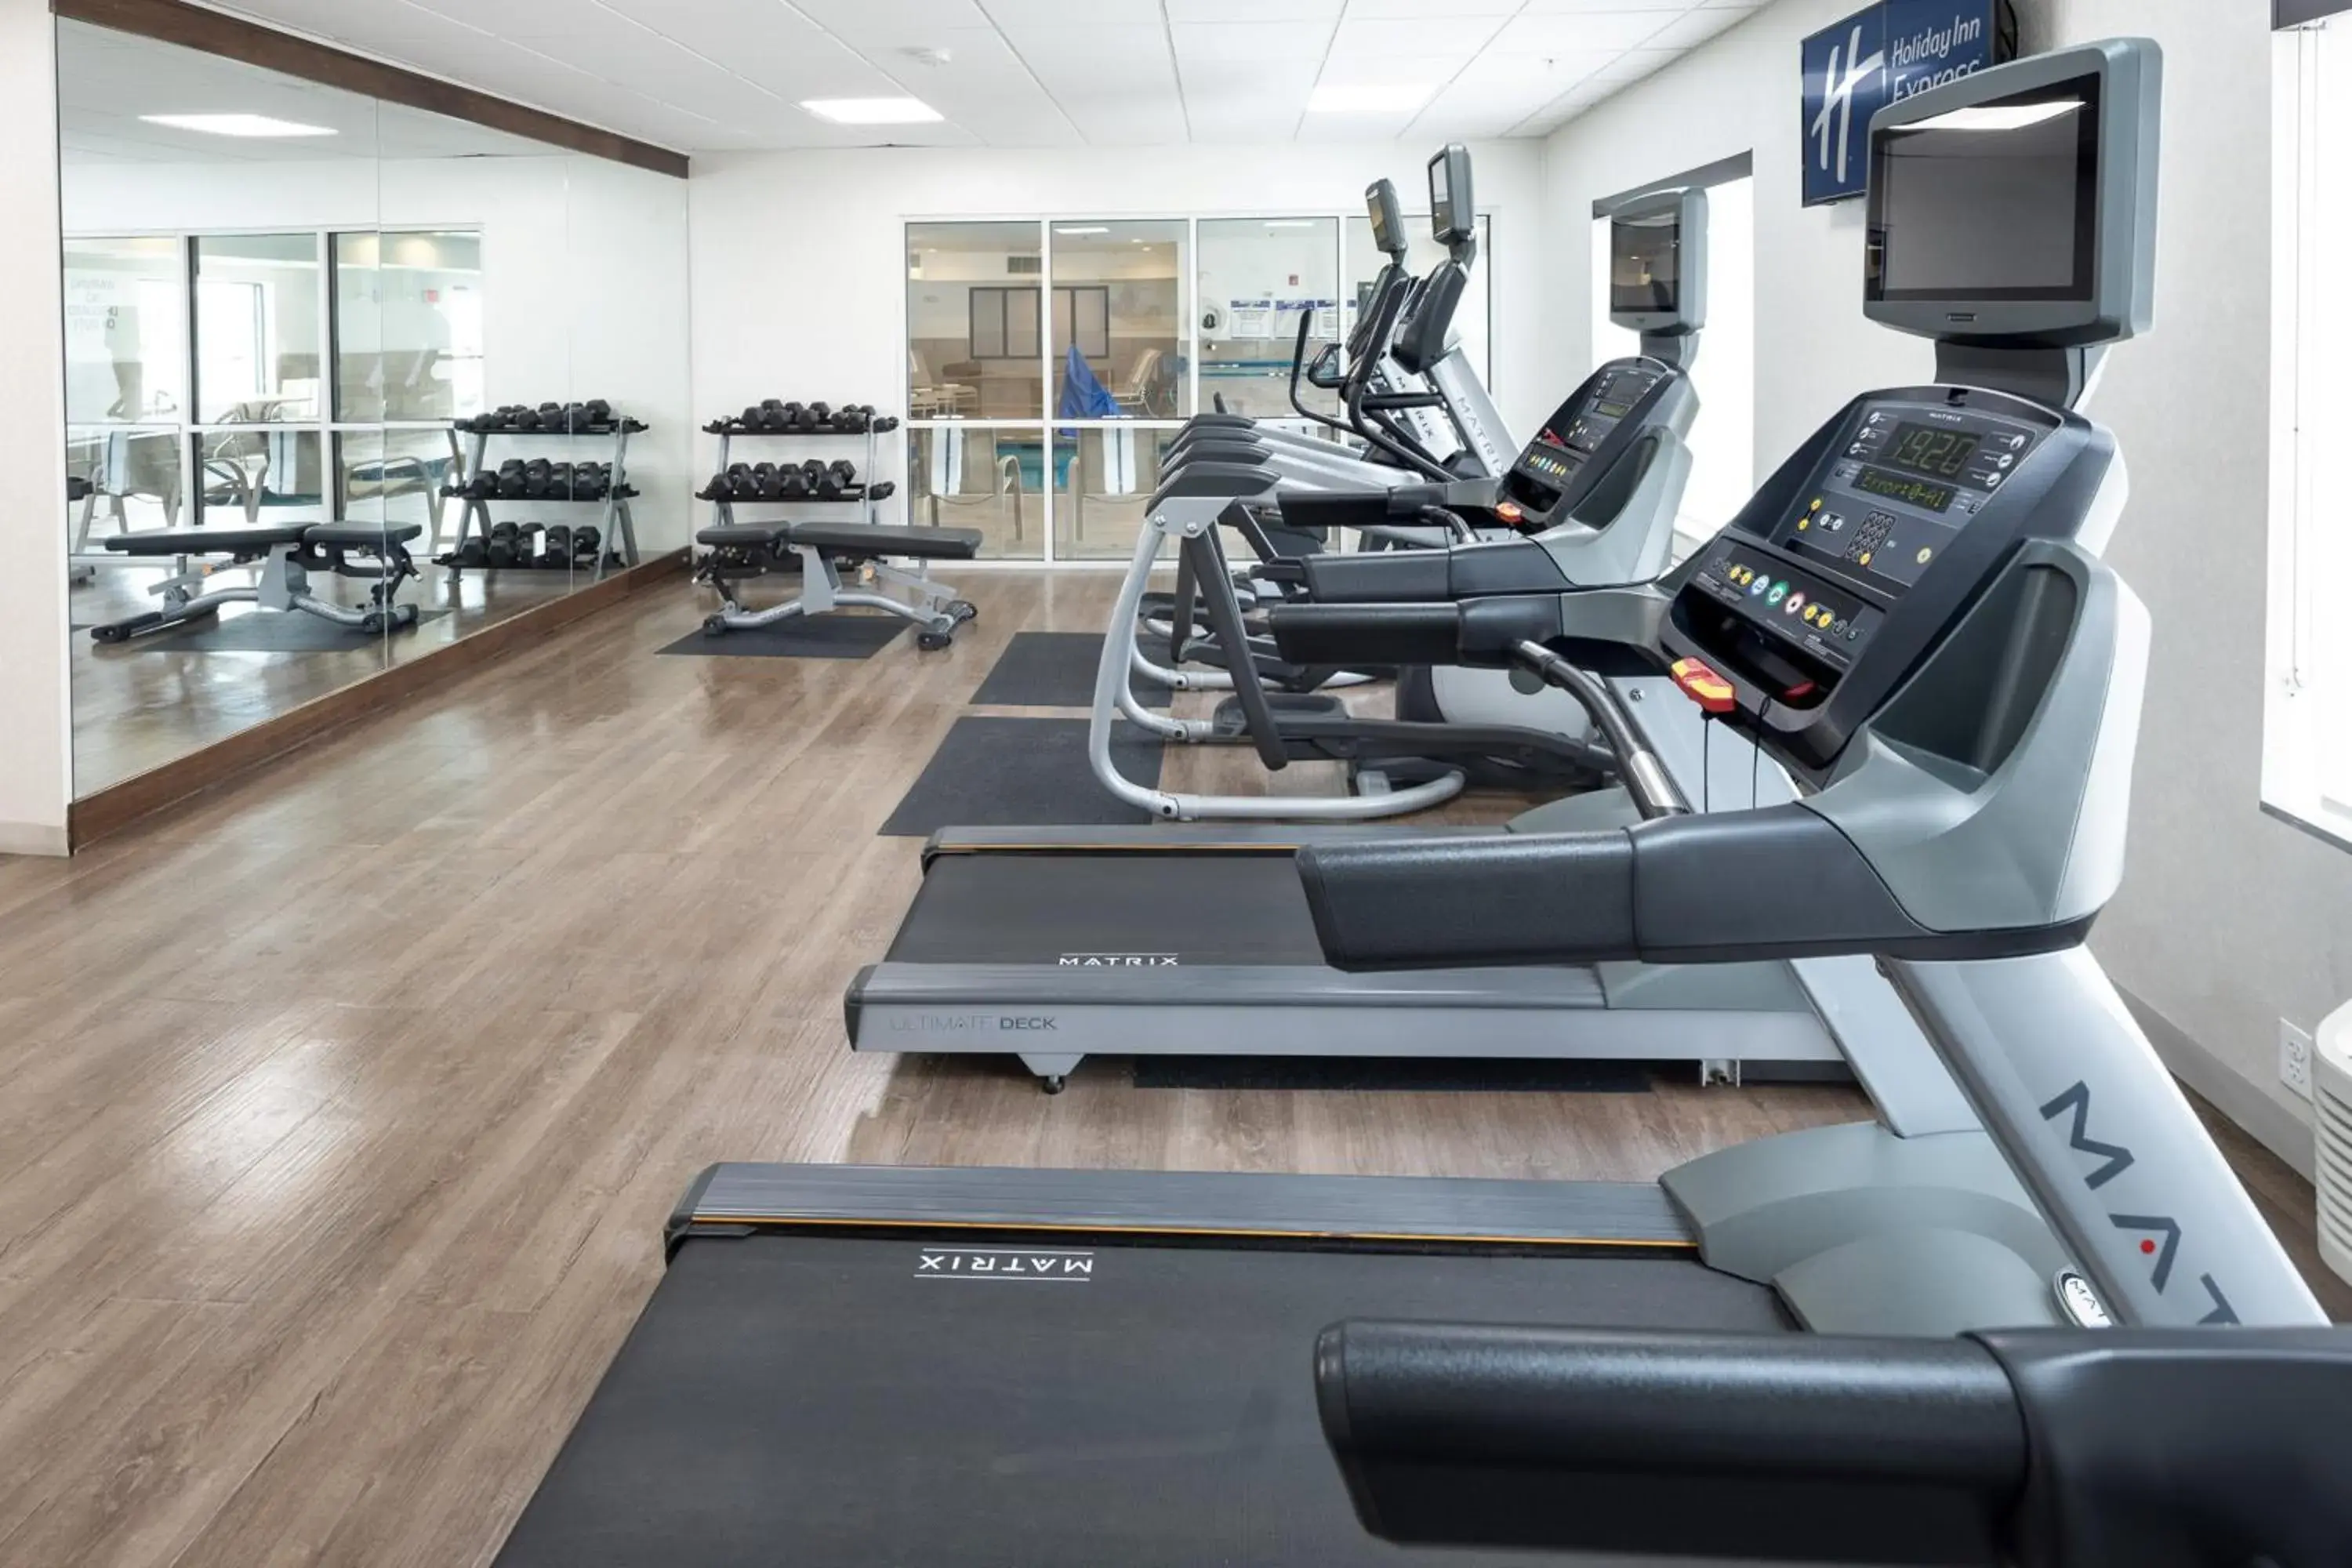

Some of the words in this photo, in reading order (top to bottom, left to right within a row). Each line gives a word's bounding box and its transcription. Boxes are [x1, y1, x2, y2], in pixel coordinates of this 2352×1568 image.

[1892, 27, 1951, 68] Holiday
[1953, 15, 1980, 45] Inn
[1059, 957, 1178, 966] MATRIX
[1000, 1017, 1058, 1030] DECK
[919, 1255, 1092, 1273] MATRIX
